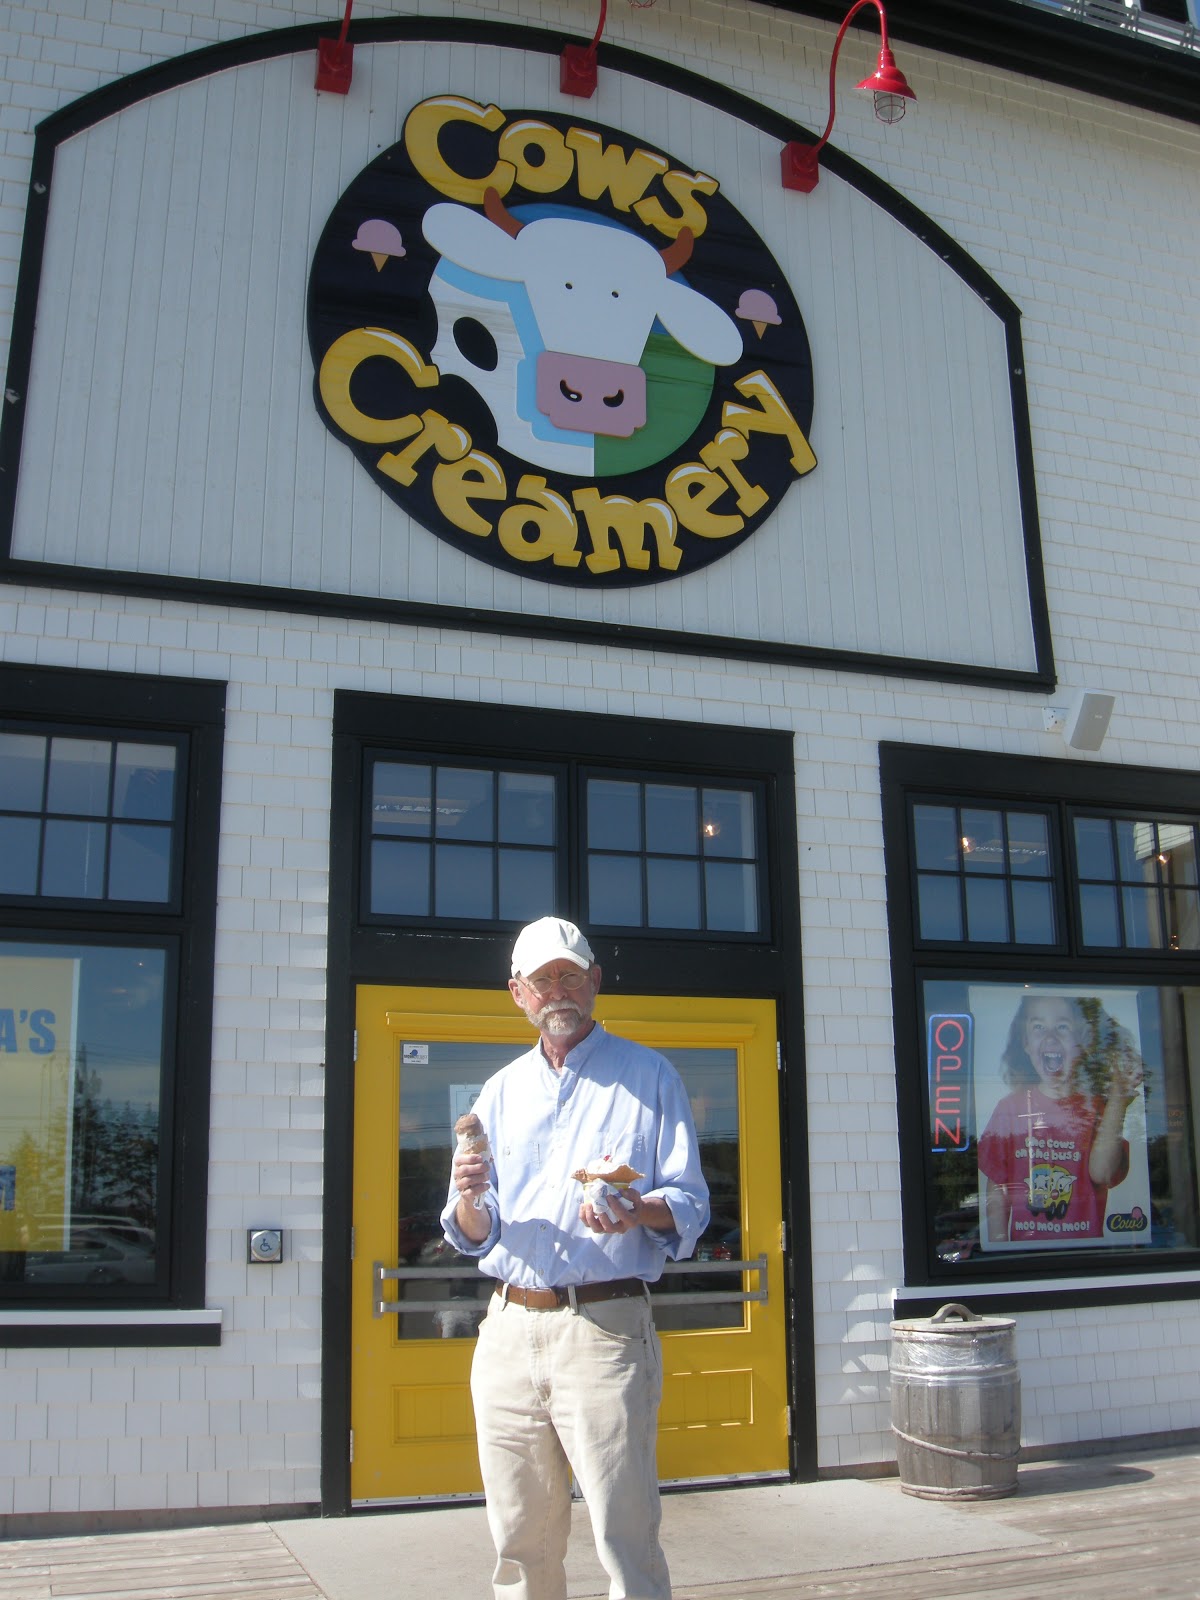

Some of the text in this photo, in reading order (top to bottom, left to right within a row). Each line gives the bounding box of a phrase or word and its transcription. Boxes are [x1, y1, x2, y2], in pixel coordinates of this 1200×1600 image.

[319, 326, 818, 574] Creamery
[935, 1020, 964, 1145] OPEN
[1110, 1215, 1144, 1230] Cows
